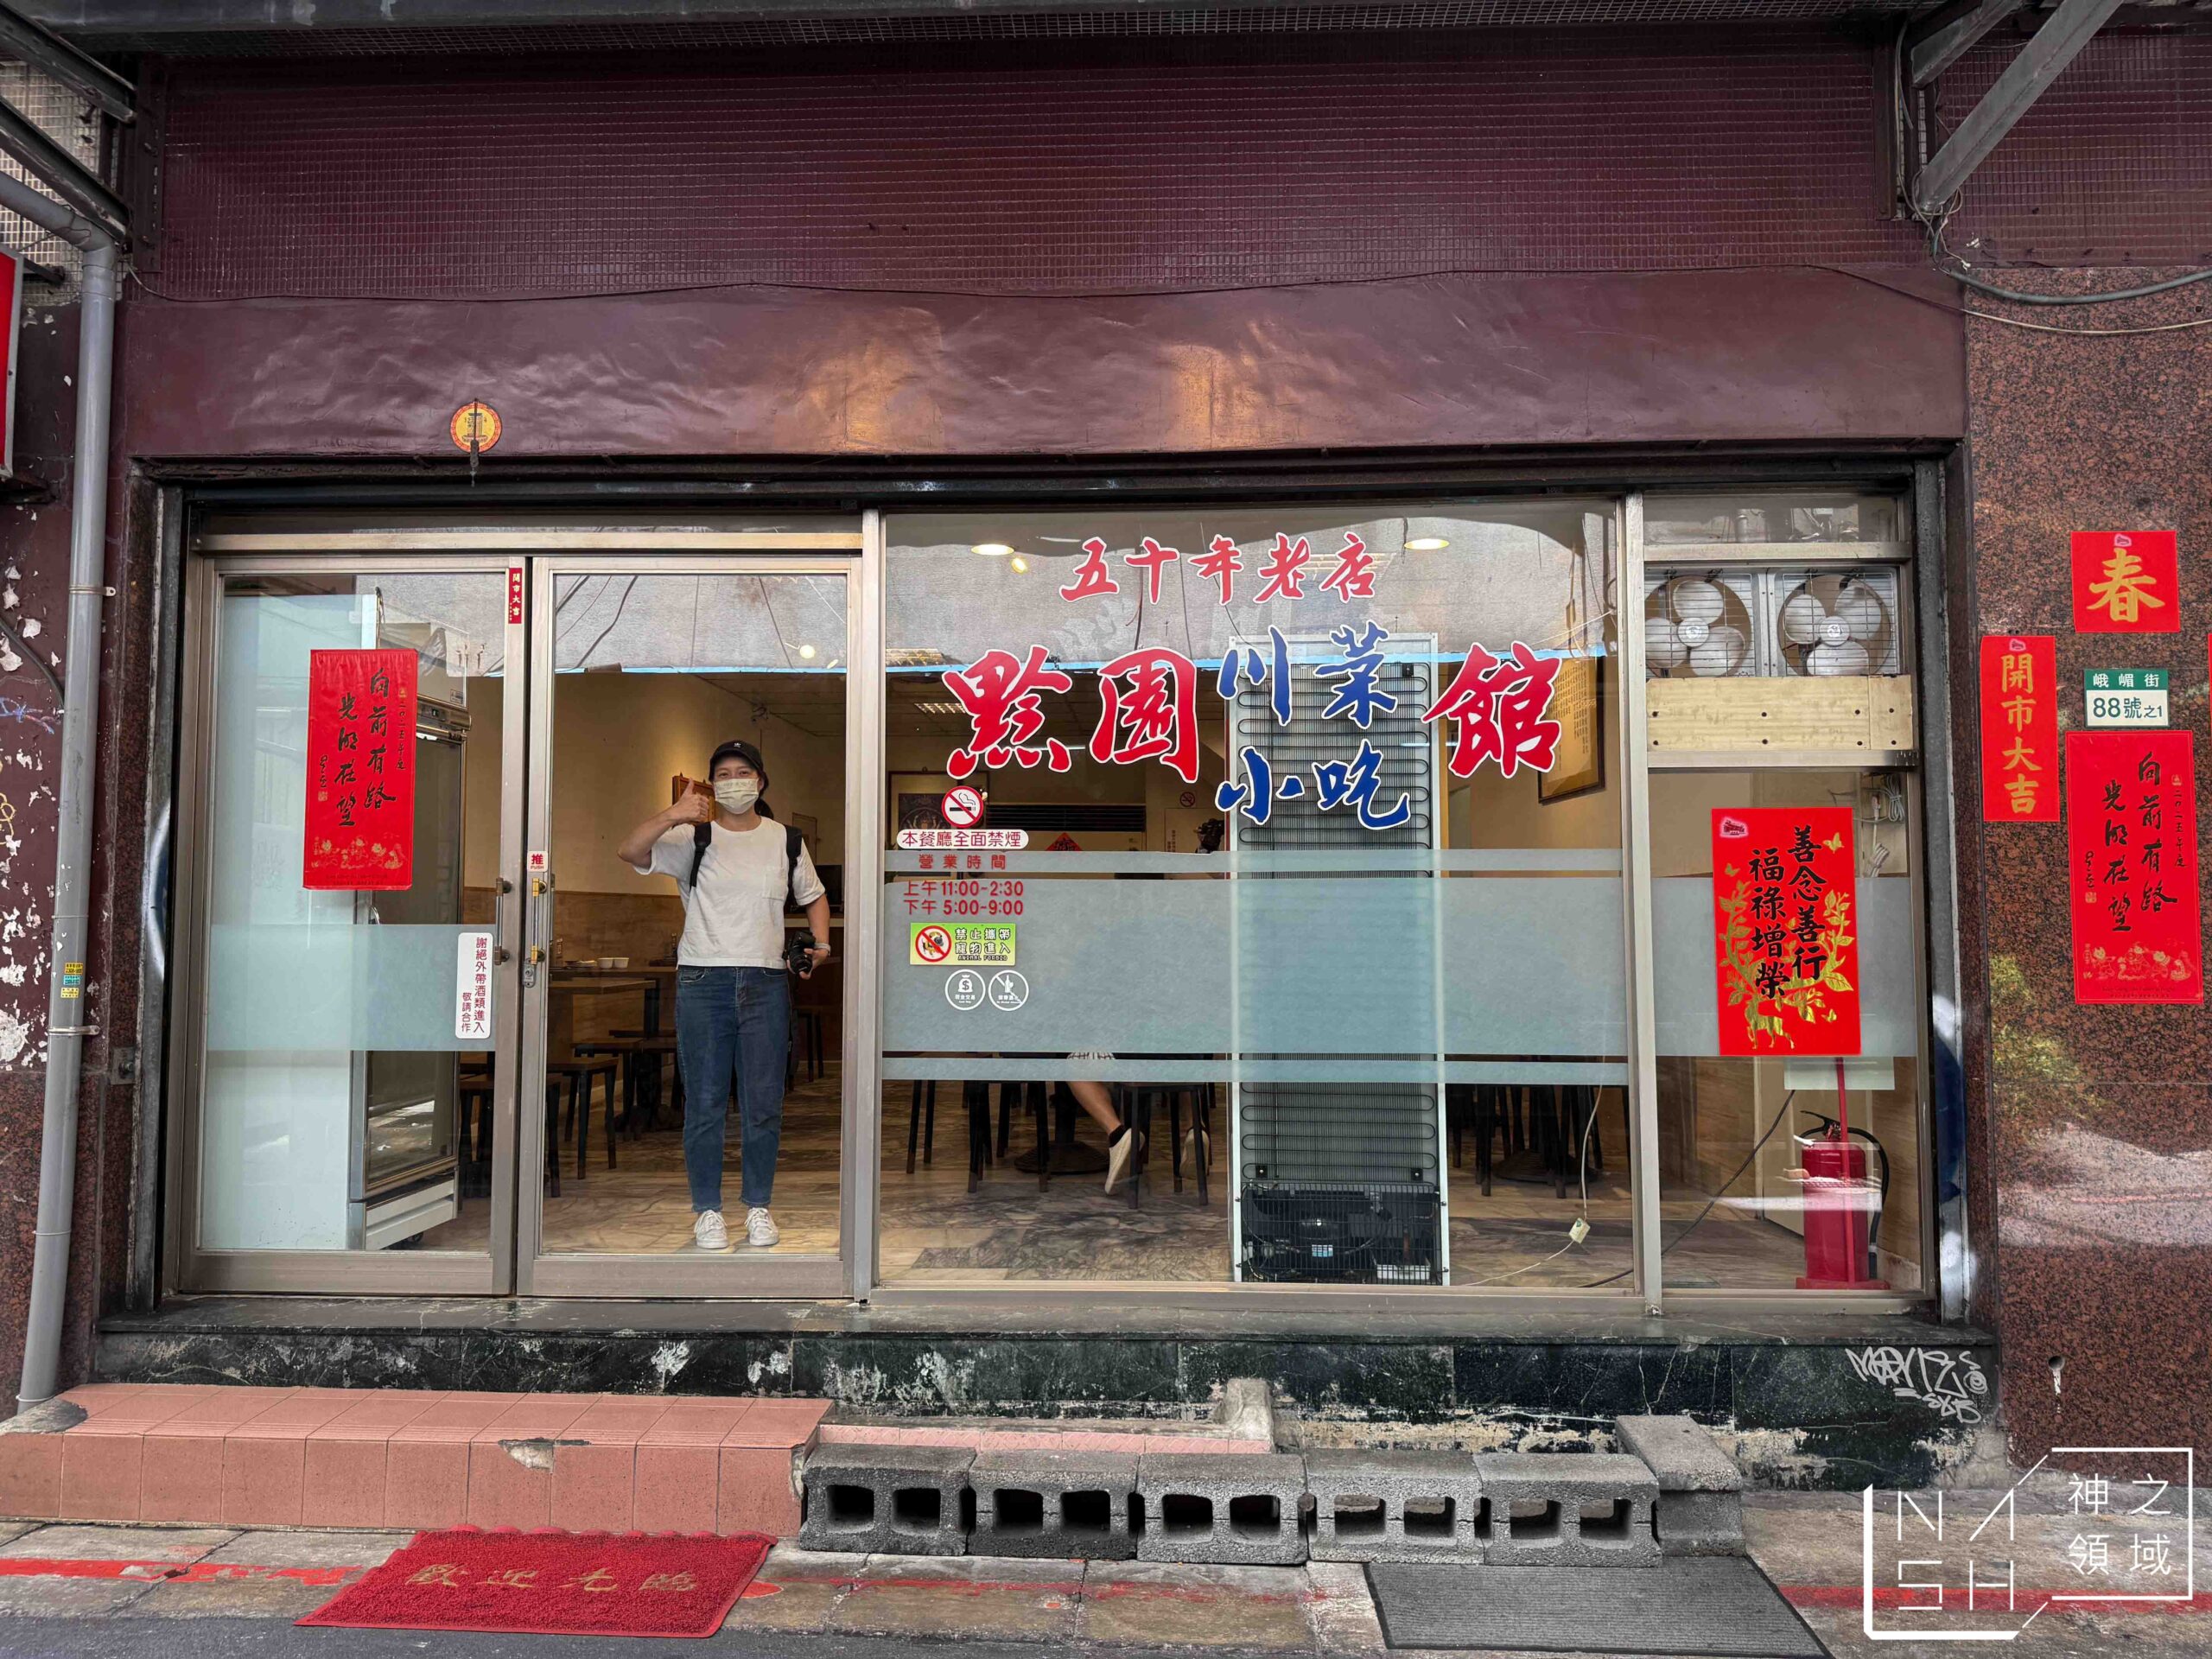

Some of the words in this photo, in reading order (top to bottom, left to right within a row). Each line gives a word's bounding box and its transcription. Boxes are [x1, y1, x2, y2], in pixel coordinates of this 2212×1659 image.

[1059, 531, 1376, 605] 五十年老店
[2086, 547, 2166, 623] 春
[1217, 620, 1399, 730] 川菜
[1421, 640, 1562, 779] 館
[2093, 673, 2160, 688] 峨嵋街
[2093, 696, 2164, 719] 88號之1
[334, 692, 359, 826] 光明在望
[363, 667, 397, 810] 向前有路
[2000, 652, 2043, 815] 開市大吉
[1215, 739, 1411, 830] 小吃
[531, 854, 544, 865] 推
[902, 830, 1021, 848] 本餐廳全面禁煙
[918, 854, 1007, 870] 營業時間
[2101, 779, 2132, 932] 光明在望
[2137, 751, 2178, 912] 向前有路
[903, 880, 938, 896] 上午
[903, 899, 938, 916] 下午
[1748, 847, 1791, 1000] 福祿增榮
[1787, 825, 1828, 980] 善念善行
[955, 927, 1011, 941] 禁止攜帶
[955, 942, 1011, 955] 寵物進入
[461, 992, 472, 1033] 敬請合作
[474, 937, 487, 1033] 謝絕外帶酒類進入
[404, 1562, 697, 1592] 歡迎光臨
